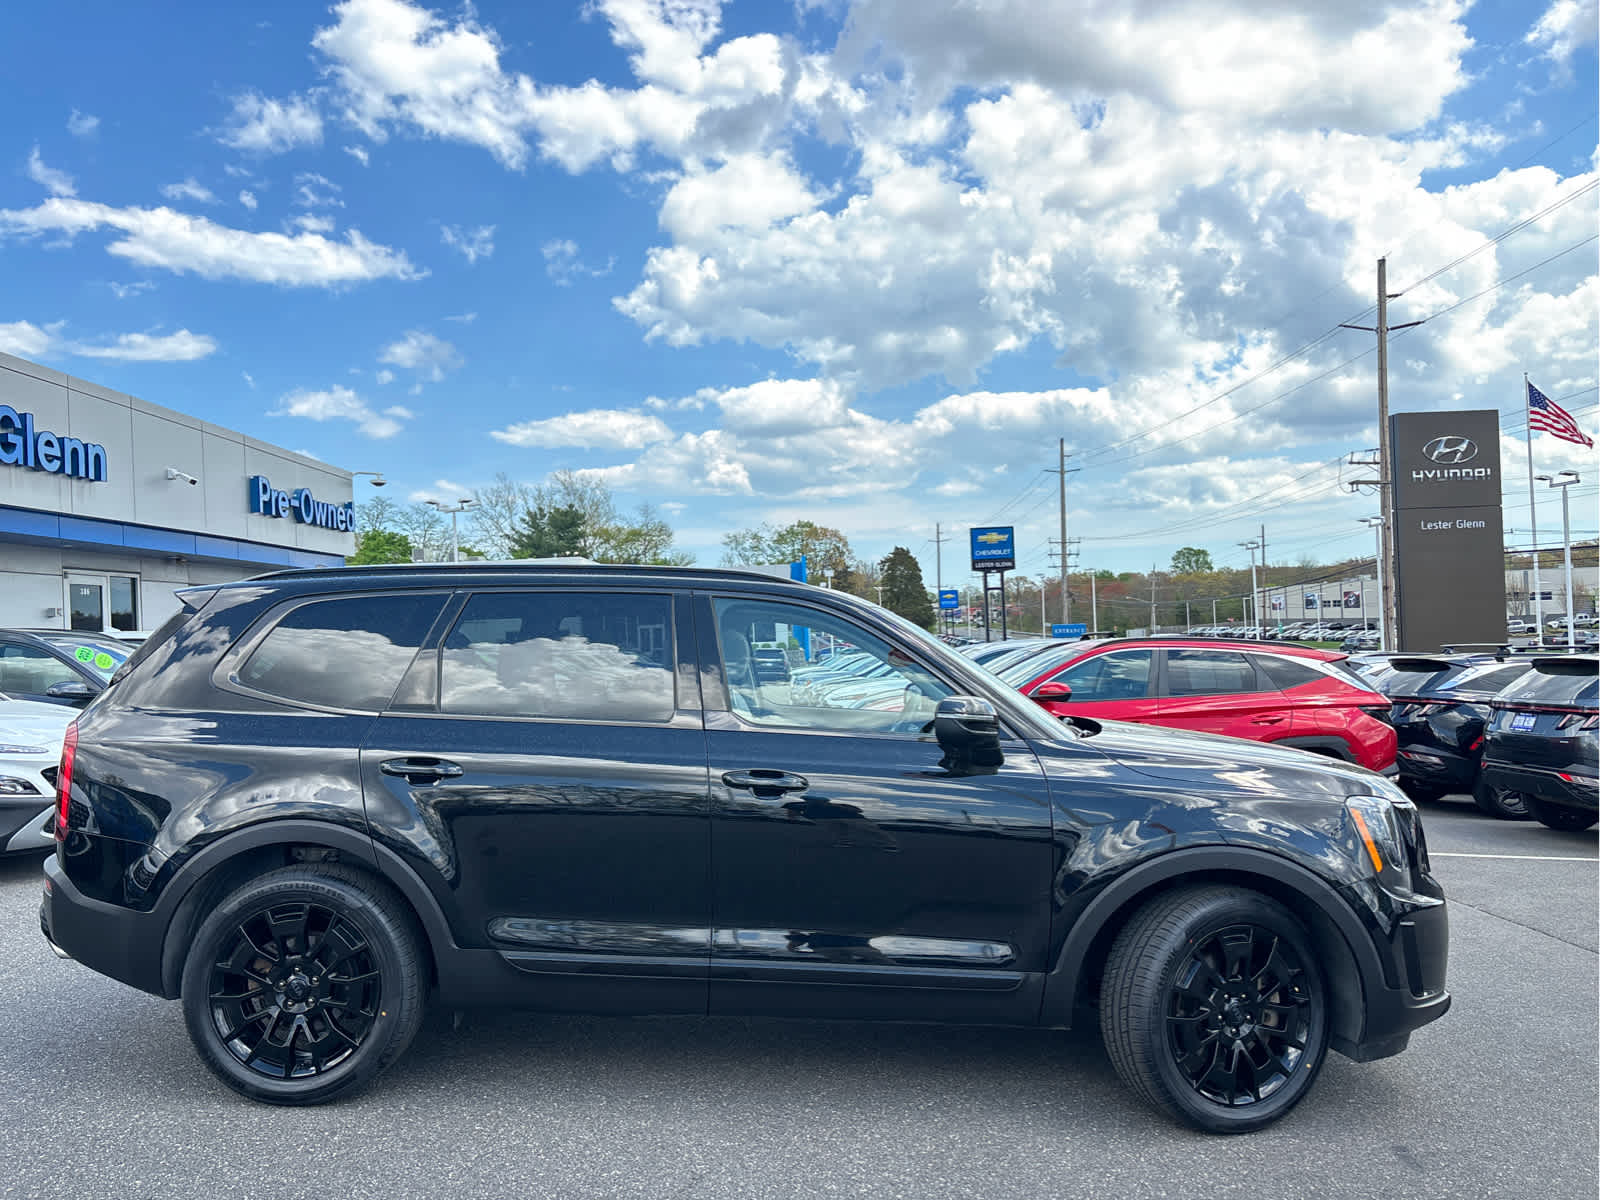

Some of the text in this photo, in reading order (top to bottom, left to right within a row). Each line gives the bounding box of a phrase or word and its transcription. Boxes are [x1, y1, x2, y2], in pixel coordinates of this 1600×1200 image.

[0, 405, 107, 482] Glenn
[1412, 468, 1491, 481] HYUNDAI
[249, 475, 355, 532] Pre-Owned
[1421, 519, 1486, 530] Lester Glenn
